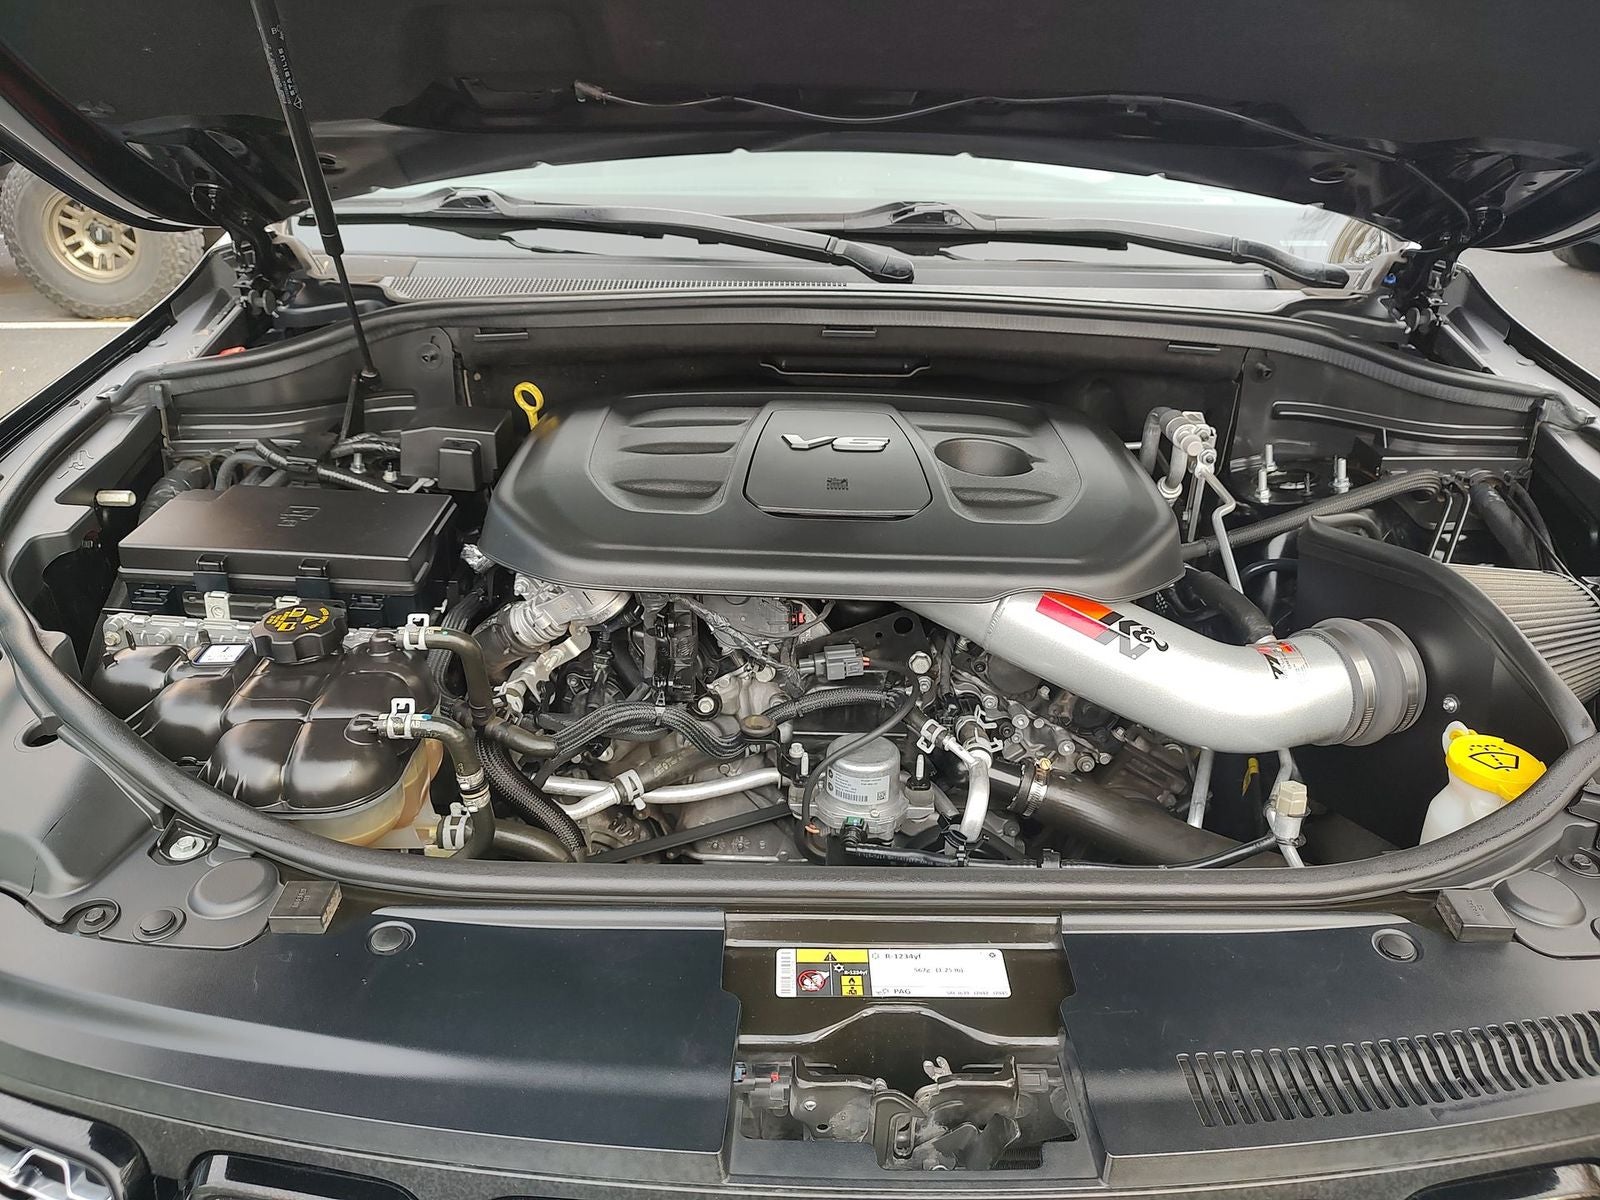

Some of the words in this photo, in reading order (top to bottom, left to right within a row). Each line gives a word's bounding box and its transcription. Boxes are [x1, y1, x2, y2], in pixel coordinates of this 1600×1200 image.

[278, 48, 296, 96] STABILUS
[781, 433, 890, 453] V6
[884, 952, 922, 961] R-1234yf
[893, 987, 912, 995] PAG
